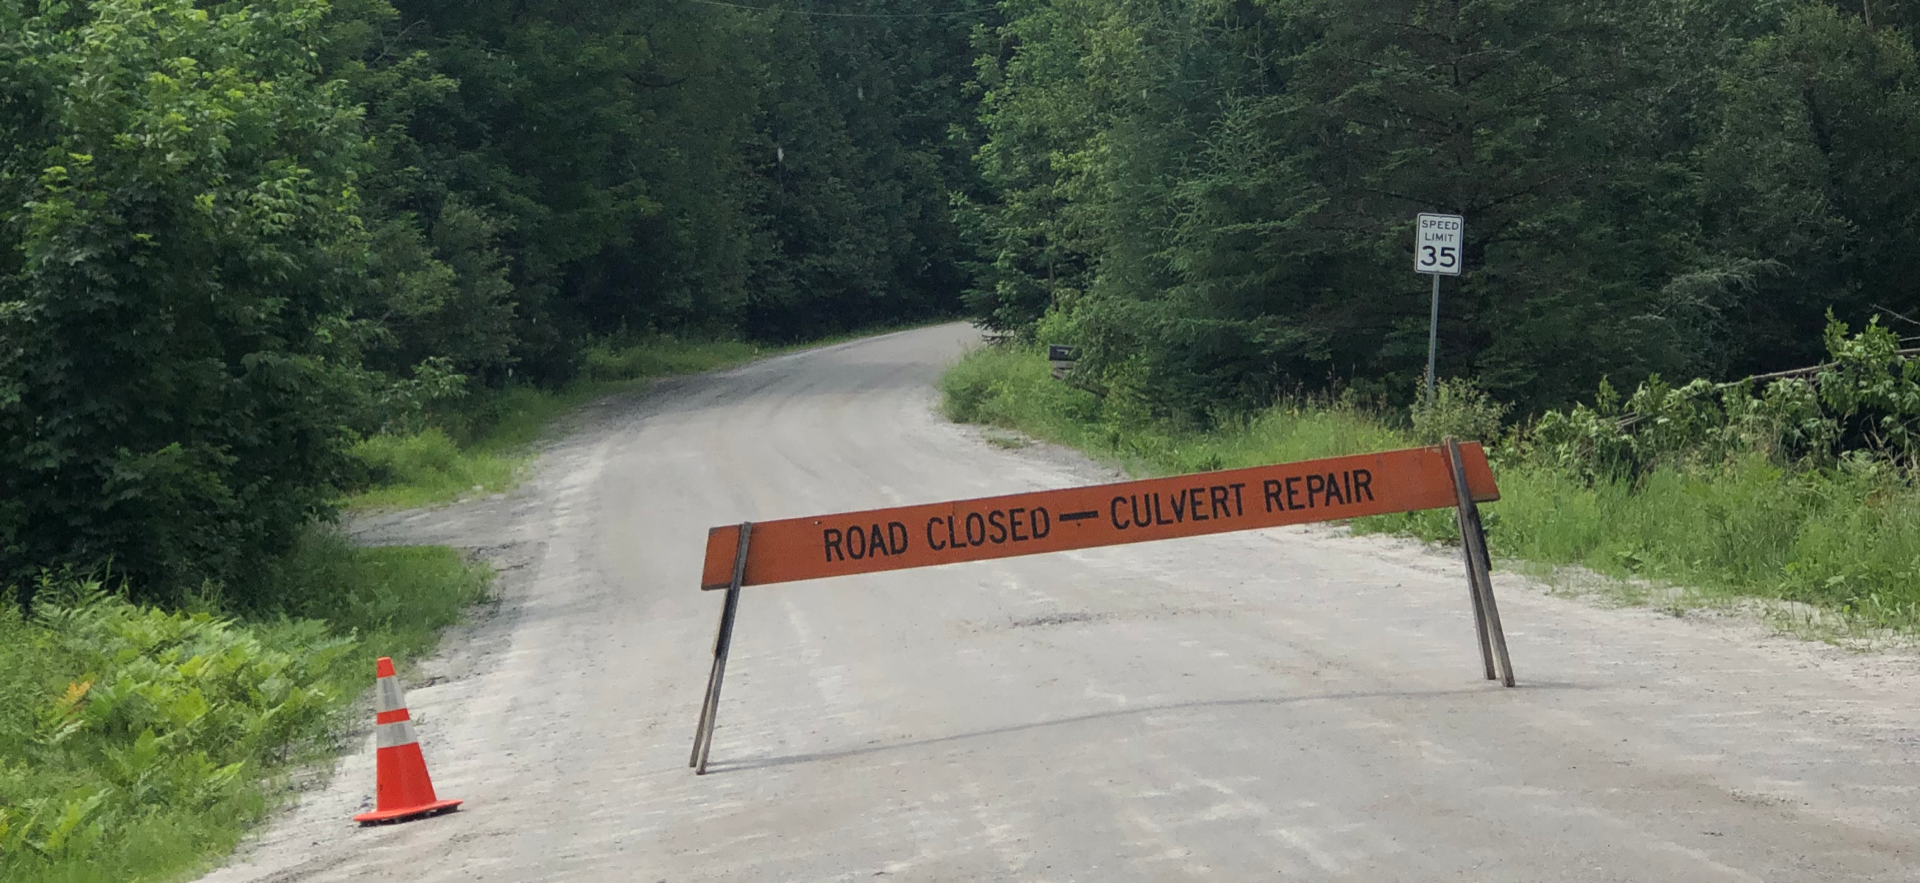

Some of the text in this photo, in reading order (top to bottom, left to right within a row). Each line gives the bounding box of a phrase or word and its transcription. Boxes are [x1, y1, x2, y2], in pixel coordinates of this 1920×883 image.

[1421, 220, 1459, 230] SPEED
[1424, 232, 1454, 242] LIMIT
[1420, 245, 1456, 268] 35
[823, 521, 908, 562] ROAD
[926, 506, 1050, 551] CLOSED
[1110, 482, 1246, 530] CULVERT
[1263, 468, 1375, 513] REPAIR
